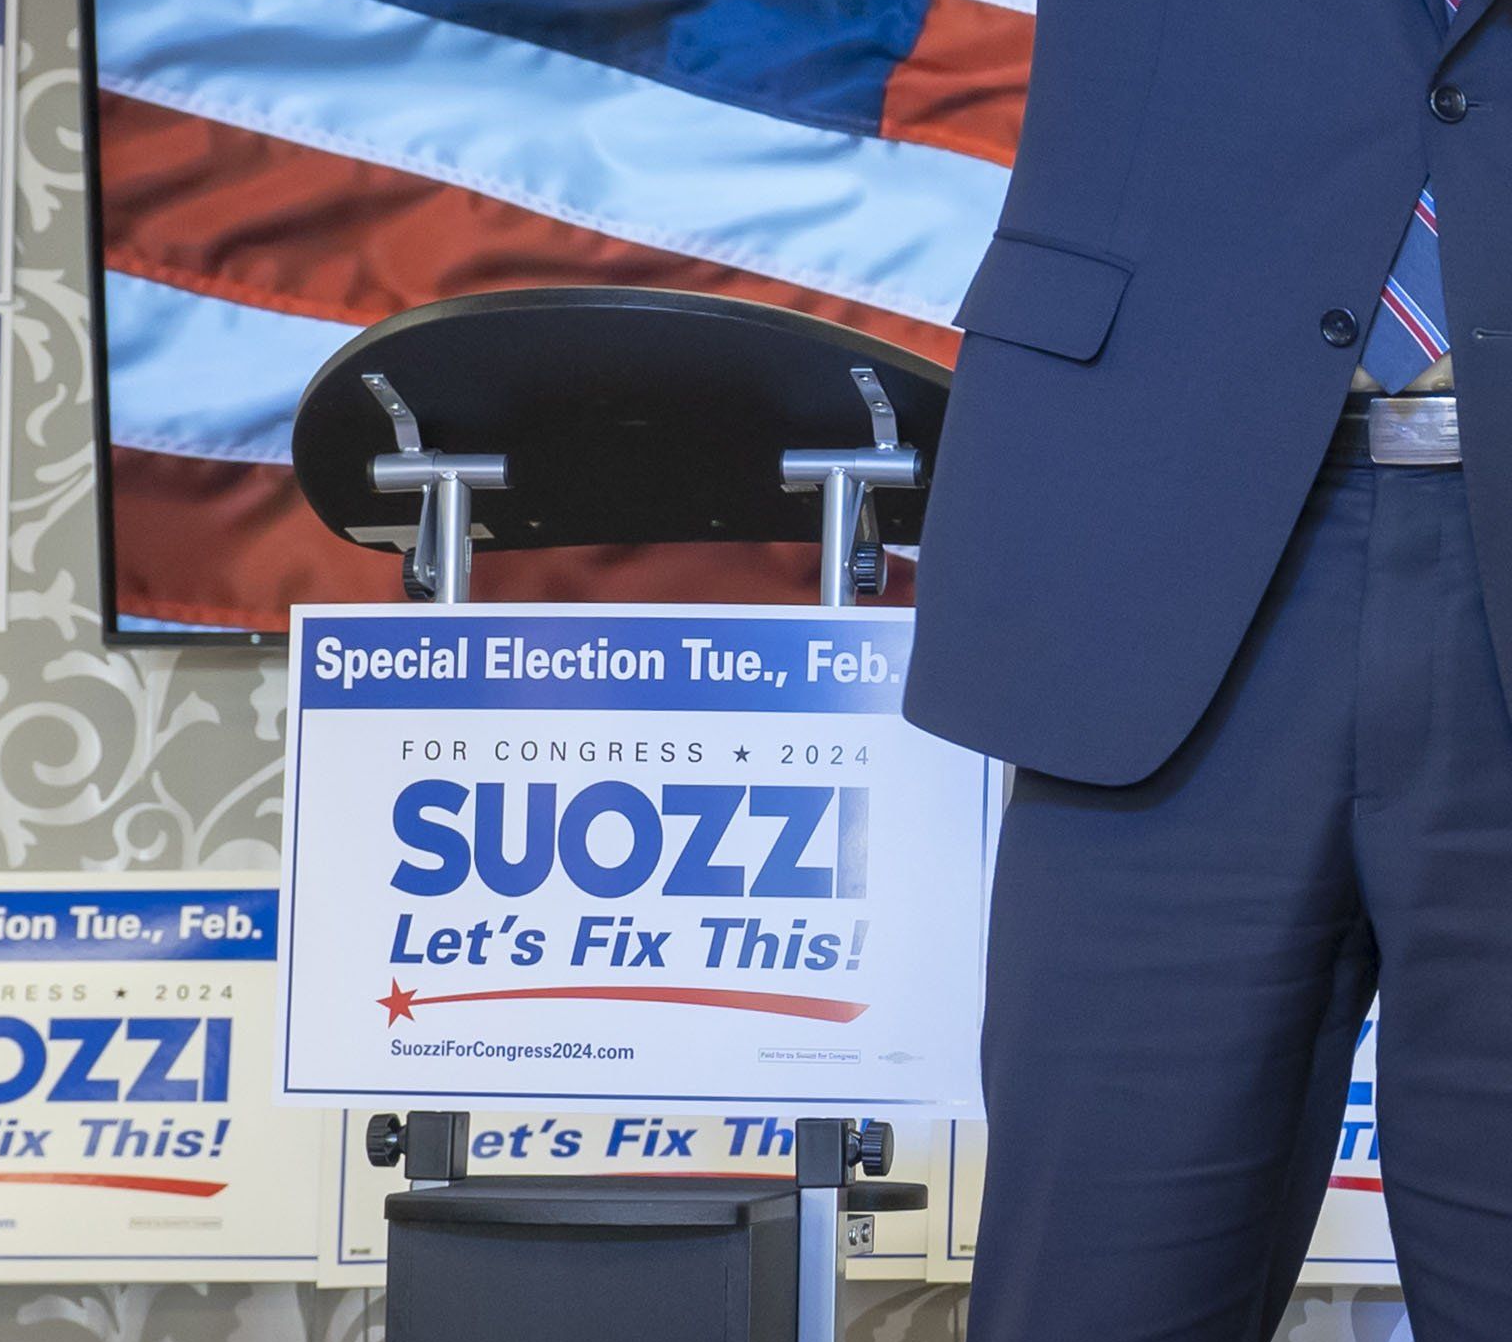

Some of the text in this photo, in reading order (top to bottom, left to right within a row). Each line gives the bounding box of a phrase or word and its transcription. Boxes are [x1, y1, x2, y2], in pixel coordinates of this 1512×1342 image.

[316, 637, 899, 689] Special Election Tue., Feb.
[403, 741, 868, 764] FOR CONGRESS 2024
[390, 779, 869, 898] SUOZZI
[70, 907, 161, 944] Tue.,
[179, 906, 261, 939] Feb.
[390, 914, 870, 970] Let's Fix This!
[156, 985, 232, 1001] 2024
[391, 1039, 633, 1061] SuozziForCongress2024.com
[81, 1119, 230, 1157] This!
[471, 1119, 582, 1158] et's
[606, 1118, 697, 1156] Fix
